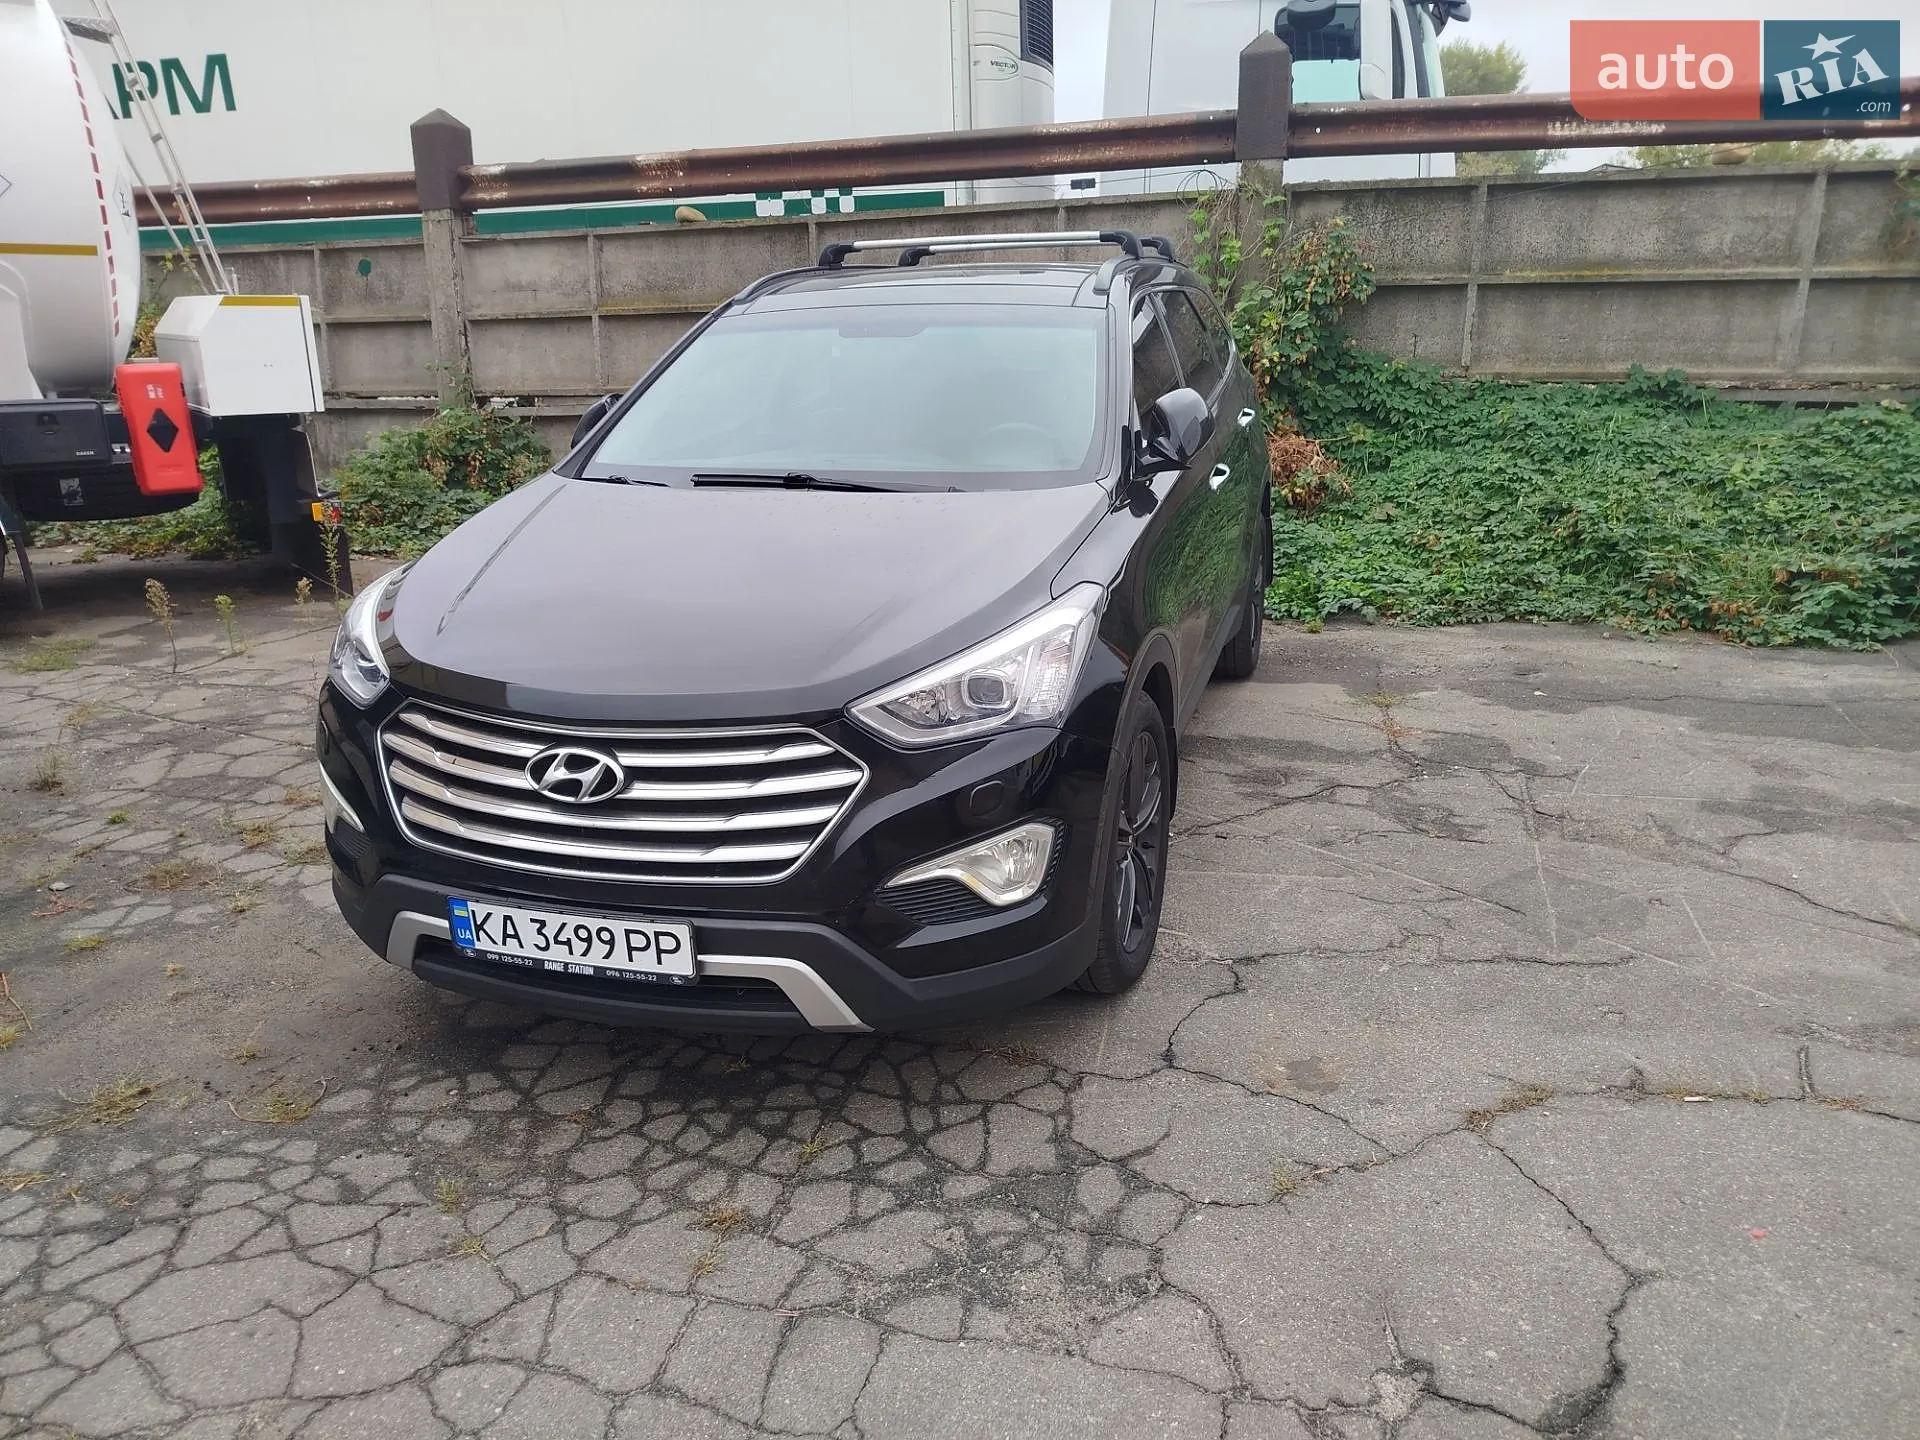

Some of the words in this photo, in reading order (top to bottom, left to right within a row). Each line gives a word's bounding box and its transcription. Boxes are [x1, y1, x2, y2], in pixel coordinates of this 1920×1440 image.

[457, 927, 473, 940] UA
[470, 909, 525, 949] KA
[529, 917, 616, 960] 3499
[624, 928, 682, 965] PP
[486, 952, 499, 961] 099
[544, 960, 565, 972] RANGE
[567, 964, 594, 976] STATION
